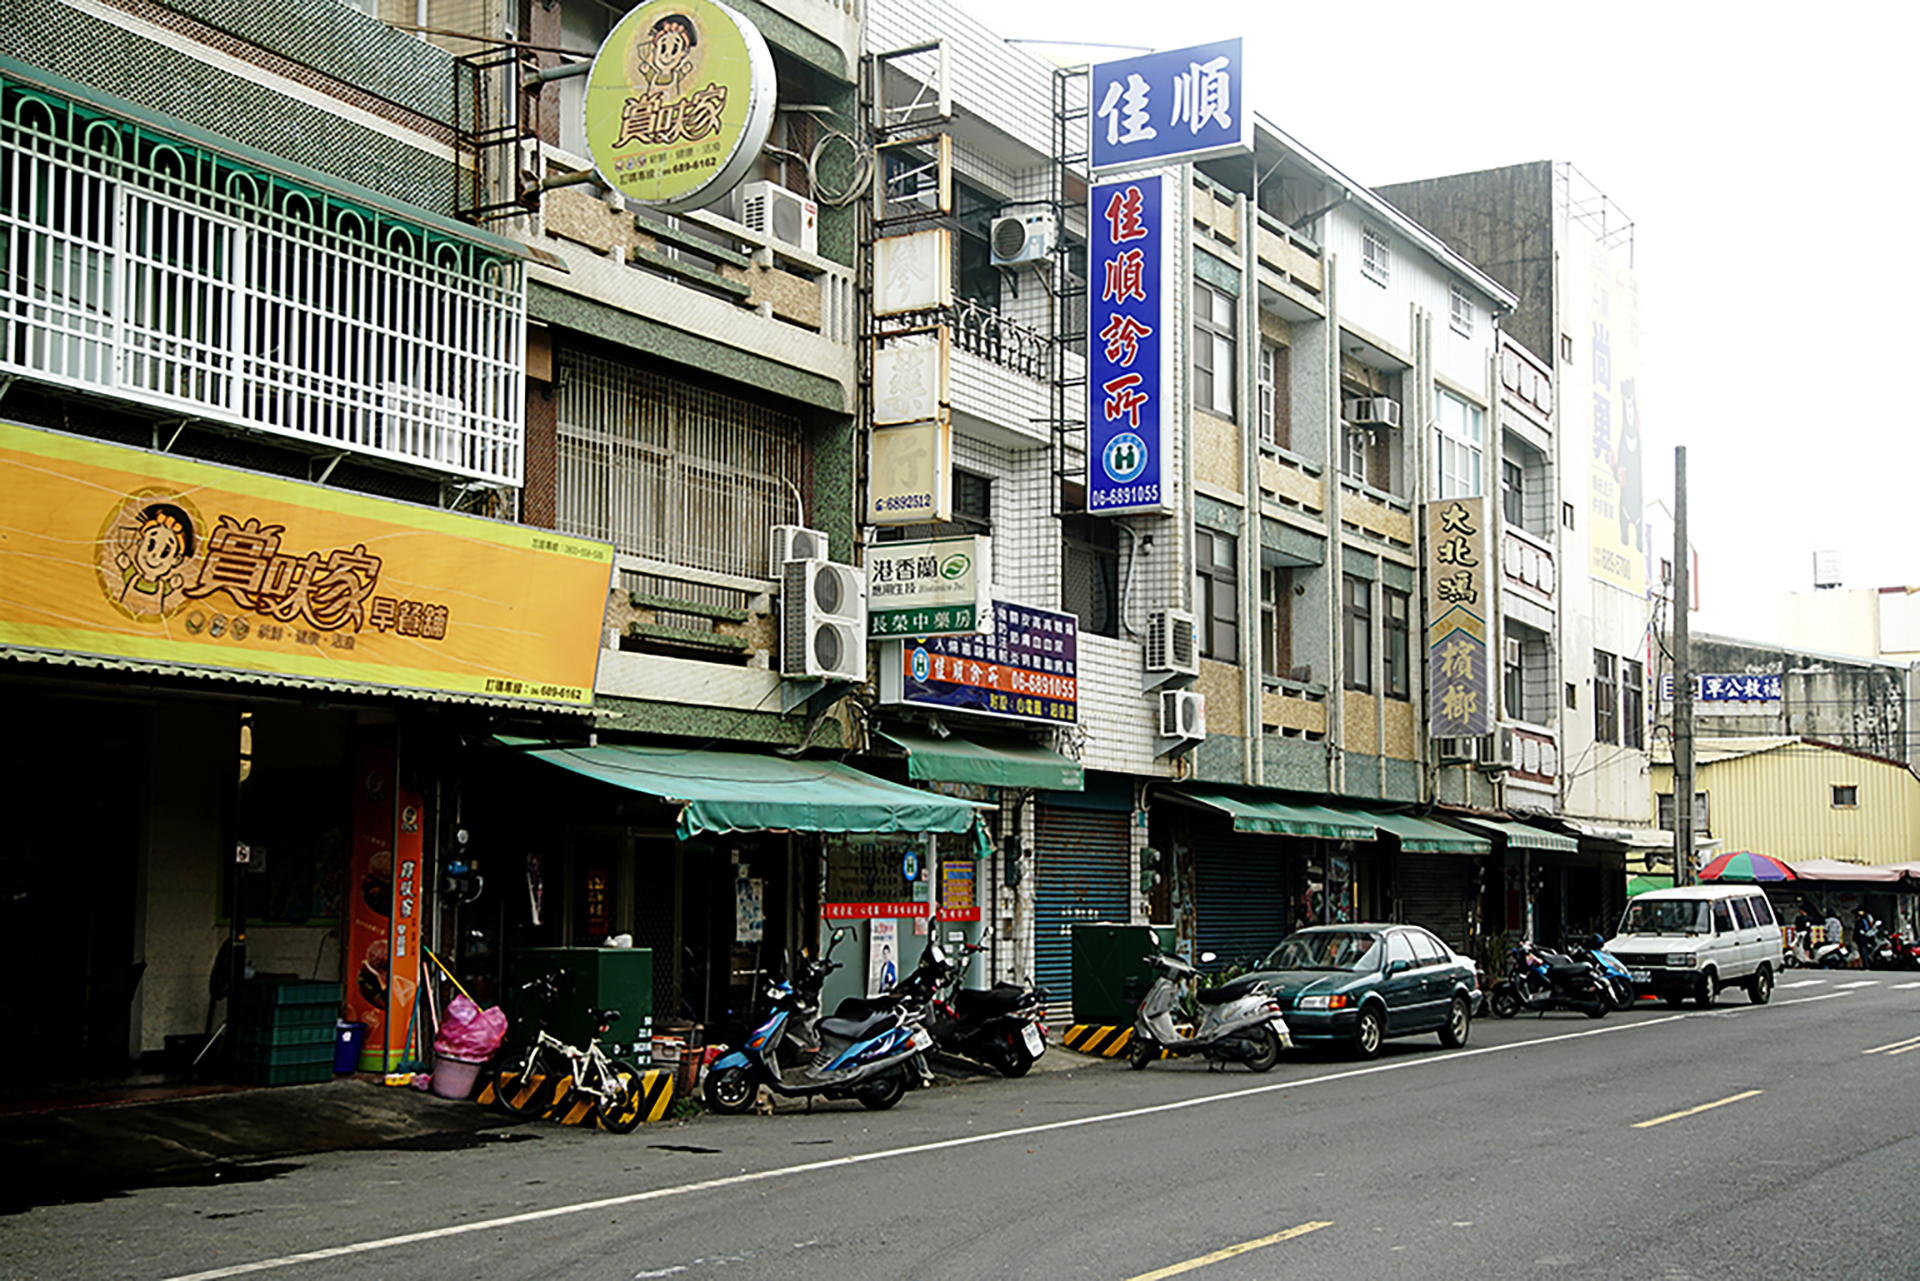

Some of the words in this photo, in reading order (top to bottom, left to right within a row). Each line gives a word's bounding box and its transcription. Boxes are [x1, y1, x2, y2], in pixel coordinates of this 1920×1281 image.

[612, 82, 728, 149] 賞味家
[1097, 55, 1233, 146] 佳順
[1099, 186, 1153, 428] 佳順診所
[1091, 484, 1159, 506] 06-6891055
[184, 514, 383, 634] 賞味家
[872, 556, 938, 583] 港香蘭
[871, 609, 971, 634] 長榮中藥房
[1011, 669, 1075, 698] 06-6891055
[1440, 641, 1477, 725] 檳榔
